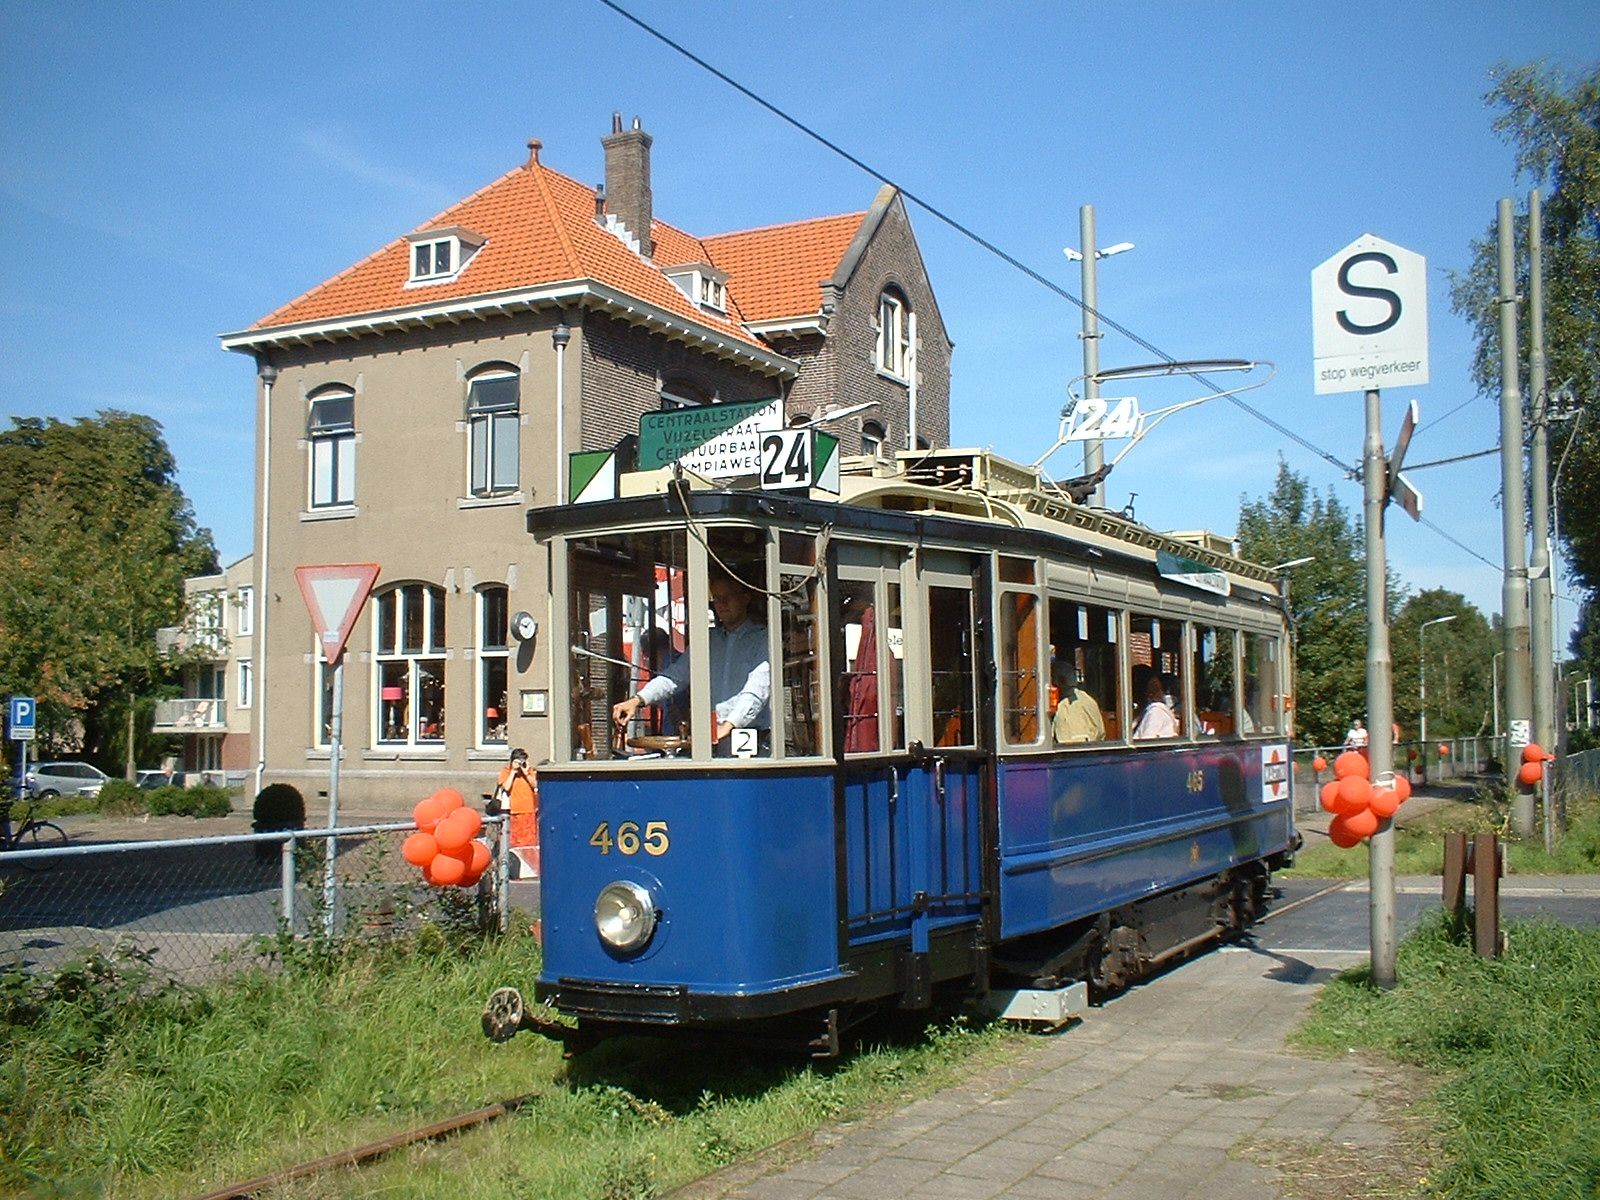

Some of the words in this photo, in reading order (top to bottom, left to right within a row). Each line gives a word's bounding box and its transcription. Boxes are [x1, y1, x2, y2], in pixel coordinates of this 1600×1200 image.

[1336, 251, 1402, 335] S
[1321, 368, 1347, 381] stop
[1349, 360, 1421, 379] wegverkeer
[648, 404, 777, 428] CENTRAALSTATION
[1070, 397, 1137, 440] 24
[656, 440, 761, 461] CEINTUURBAA
[763, 432, 809, 484] 24
[17, 702, 31, 724] P
[737, 731, 752, 752] 2
[589, 820, 670, 856] 465
